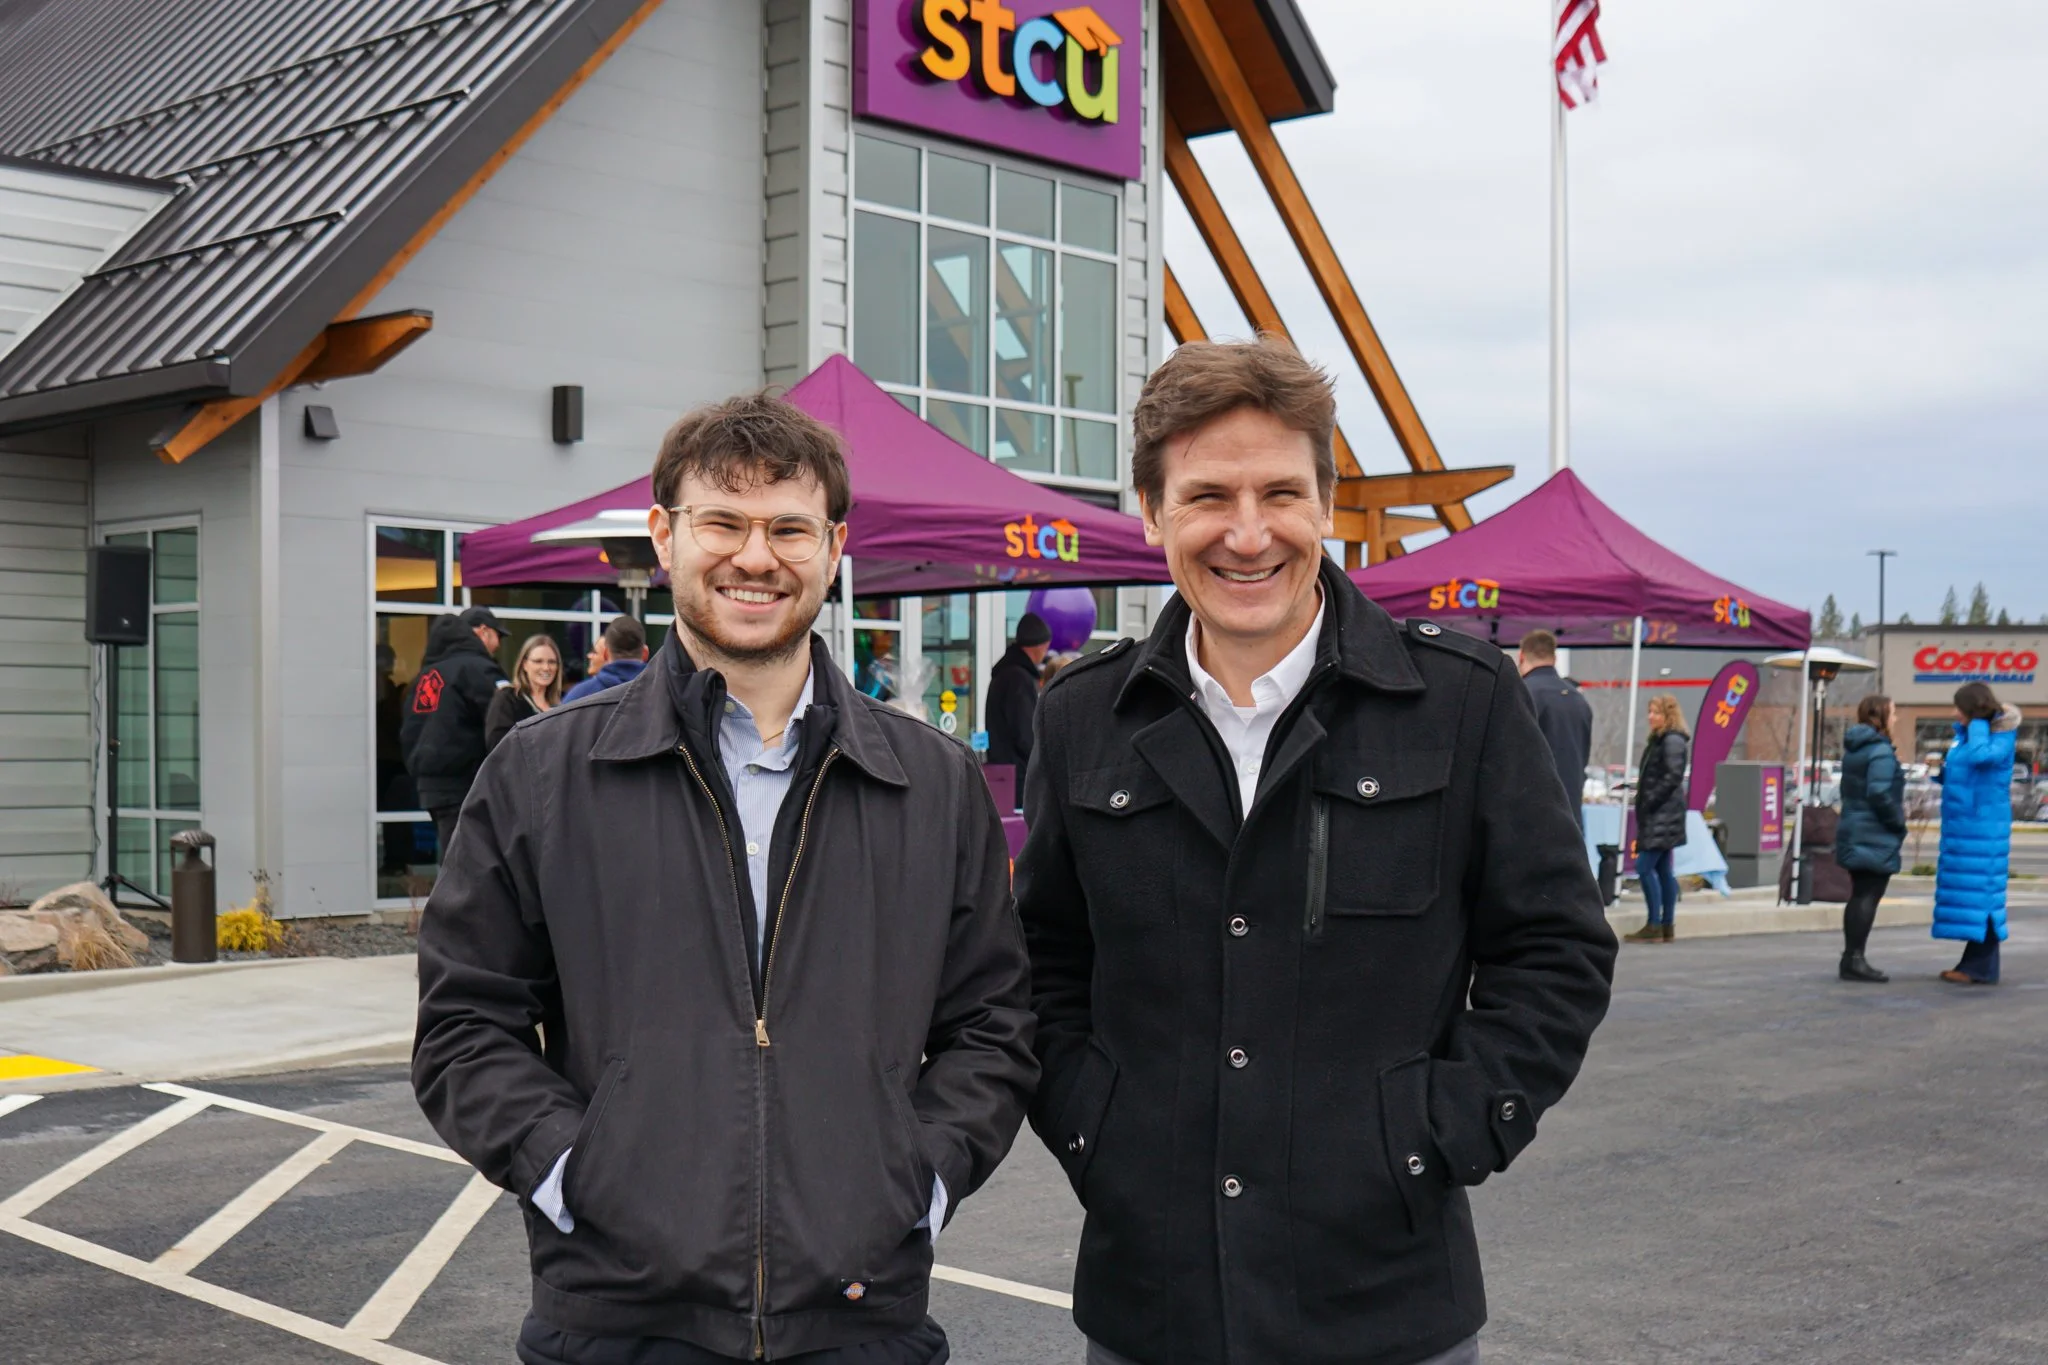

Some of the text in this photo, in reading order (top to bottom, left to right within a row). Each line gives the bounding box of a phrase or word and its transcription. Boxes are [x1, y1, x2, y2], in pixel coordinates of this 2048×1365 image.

[921, 0, 1123, 124] stcu
[1004, 513, 1079, 562] stcu
[1428, 578, 1500, 610] stcu
[1713, 594, 1751, 628] stcu
[1913, 646, 2038, 672] COSTCO
[1714, 674, 1749, 728] stcu
